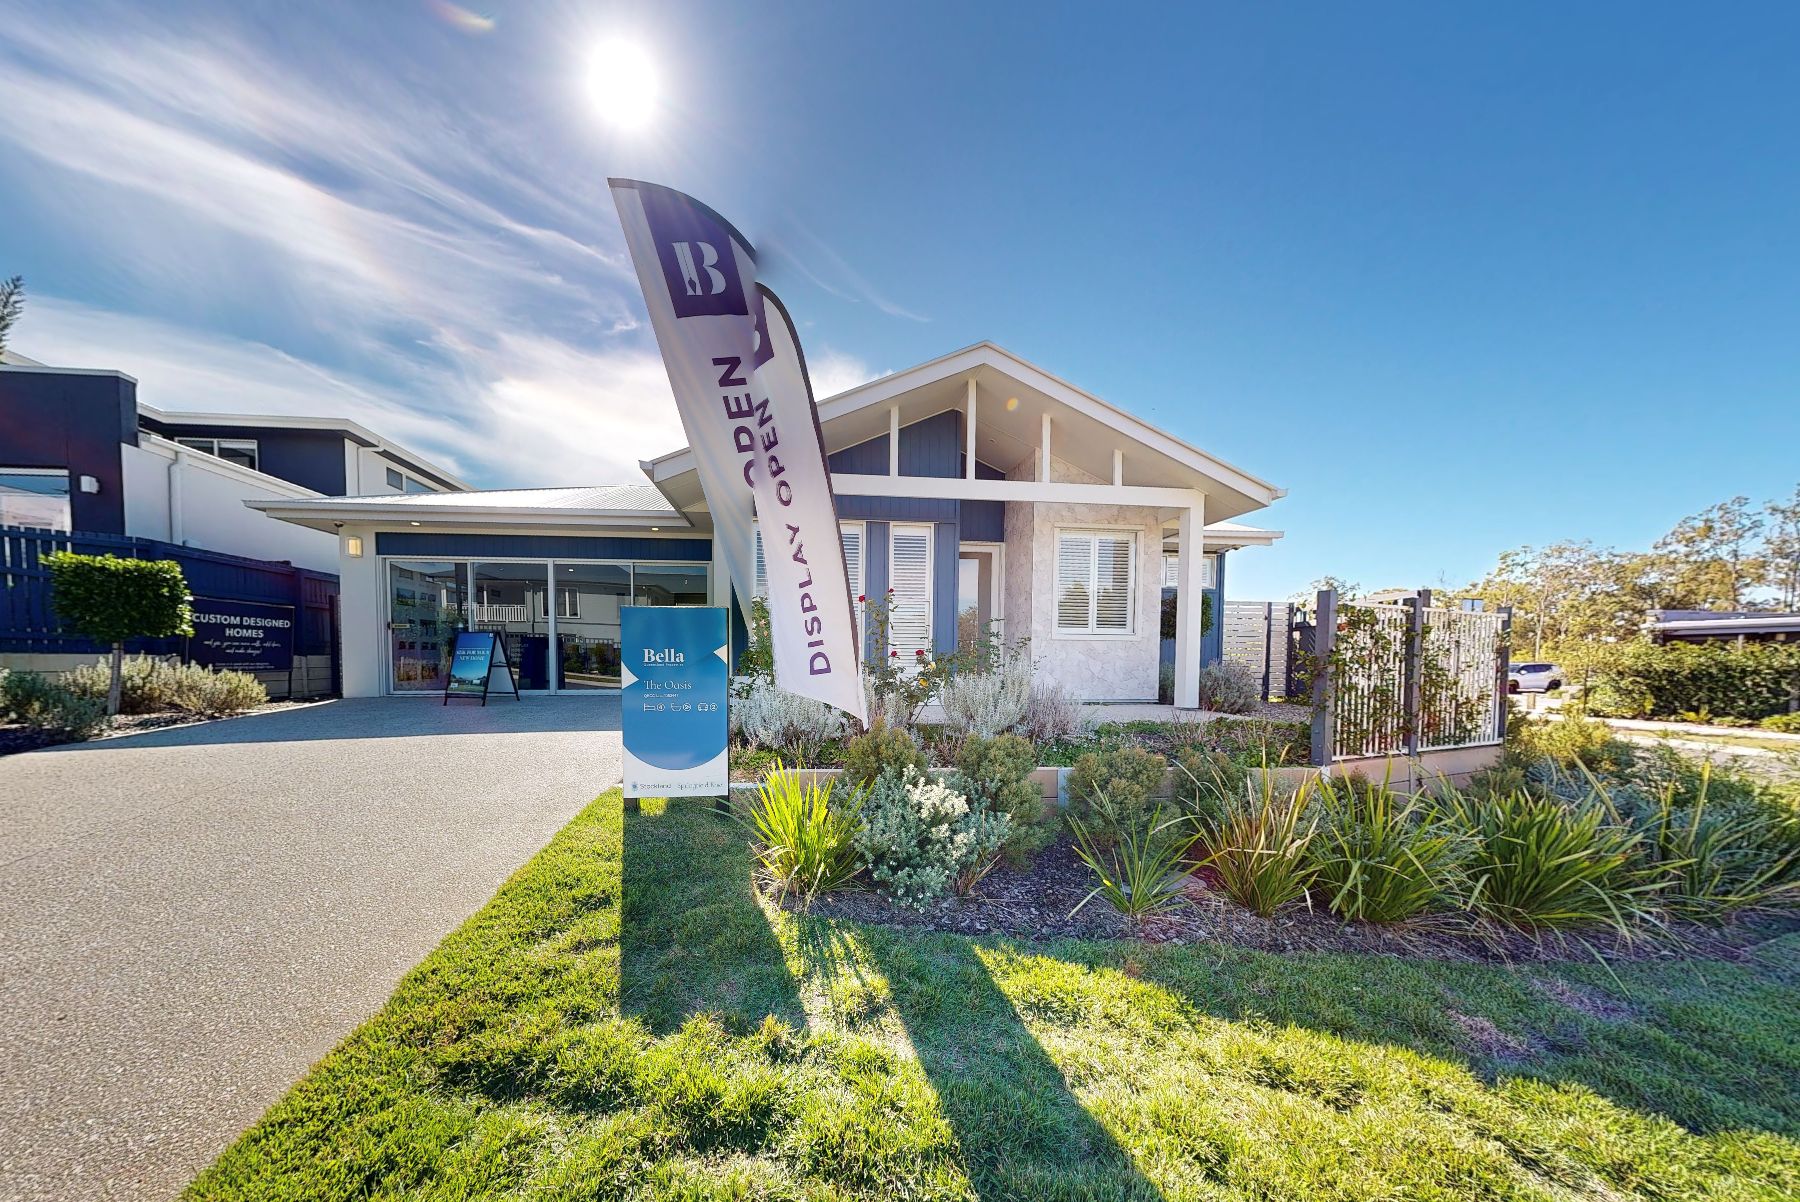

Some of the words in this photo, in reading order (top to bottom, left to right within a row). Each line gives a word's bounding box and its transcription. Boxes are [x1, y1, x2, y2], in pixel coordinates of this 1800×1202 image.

[672, 241, 727, 296] B
[754, 397, 794, 507] OPEN
[784, 522, 832, 676] DISPLAY
[192, 613, 240, 625] CUSTOM
[242, 616, 291, 628] DESIGNED
[225, 628, 265, 638] HOMES
[642, 648, 685, 663] Bella
[643, 679, 662, 690] The
[664, 679, 692, 690] Oasis
